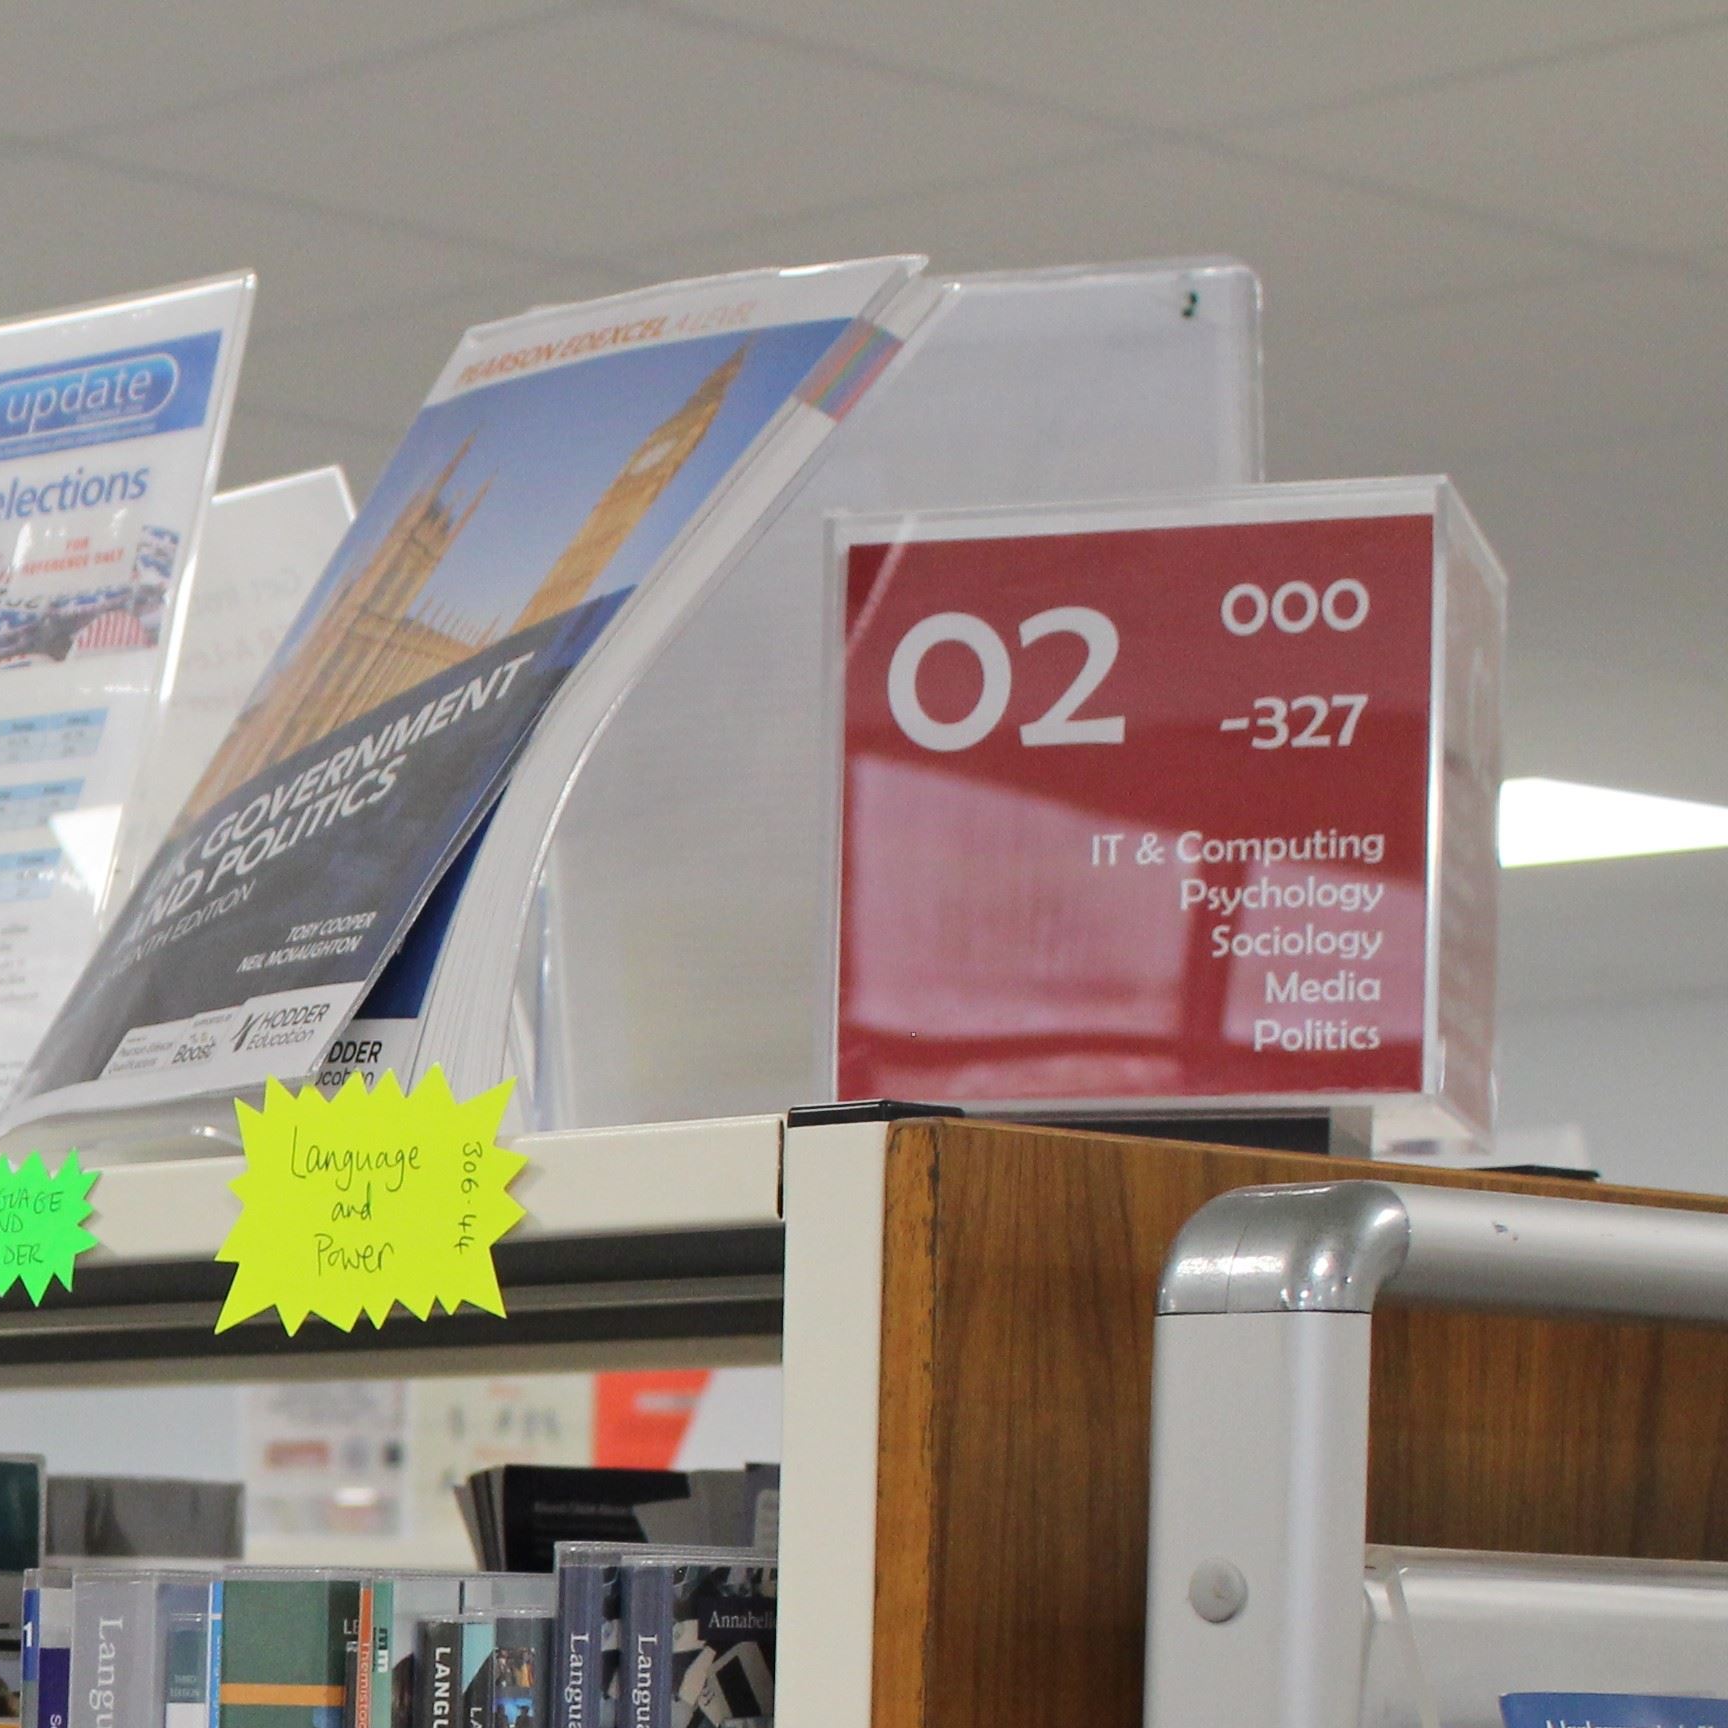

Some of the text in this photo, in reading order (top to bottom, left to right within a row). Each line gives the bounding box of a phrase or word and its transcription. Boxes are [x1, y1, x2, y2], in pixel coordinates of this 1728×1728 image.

[4, 366, 153, 433] update
[1221, 579, 1369, 636] 000
[887, 605, 1125, 751] 02
[1219, 695, 1368, 750] -327
[200, 652, 536, 860] GOVERNMENT
[206, 755, 403, 895] POLITICS
[1091, 830, 1385, 866] IT & Computing
[171, 881, 256, 943] EDITION
[1181, 878, 1384, 911] Psychology
[286, 912, 377, 943] TOBY COOPER
[1211, 925, 1382, 959] Sociology
[236, 936, 362, 973] NEIL MCNAUGHTON
[1265, 971, 1380, 1003] Media
[259, 1004, 330, 1030] HODDER
[1254, 1018, 1380, 1051] Politics
[247, 1028, 314, 1050] Education
[289, 1124, 421, 1191] Language
[332, 1197, 373, 1222] and
[314, 1233, 395, 1277] Power
